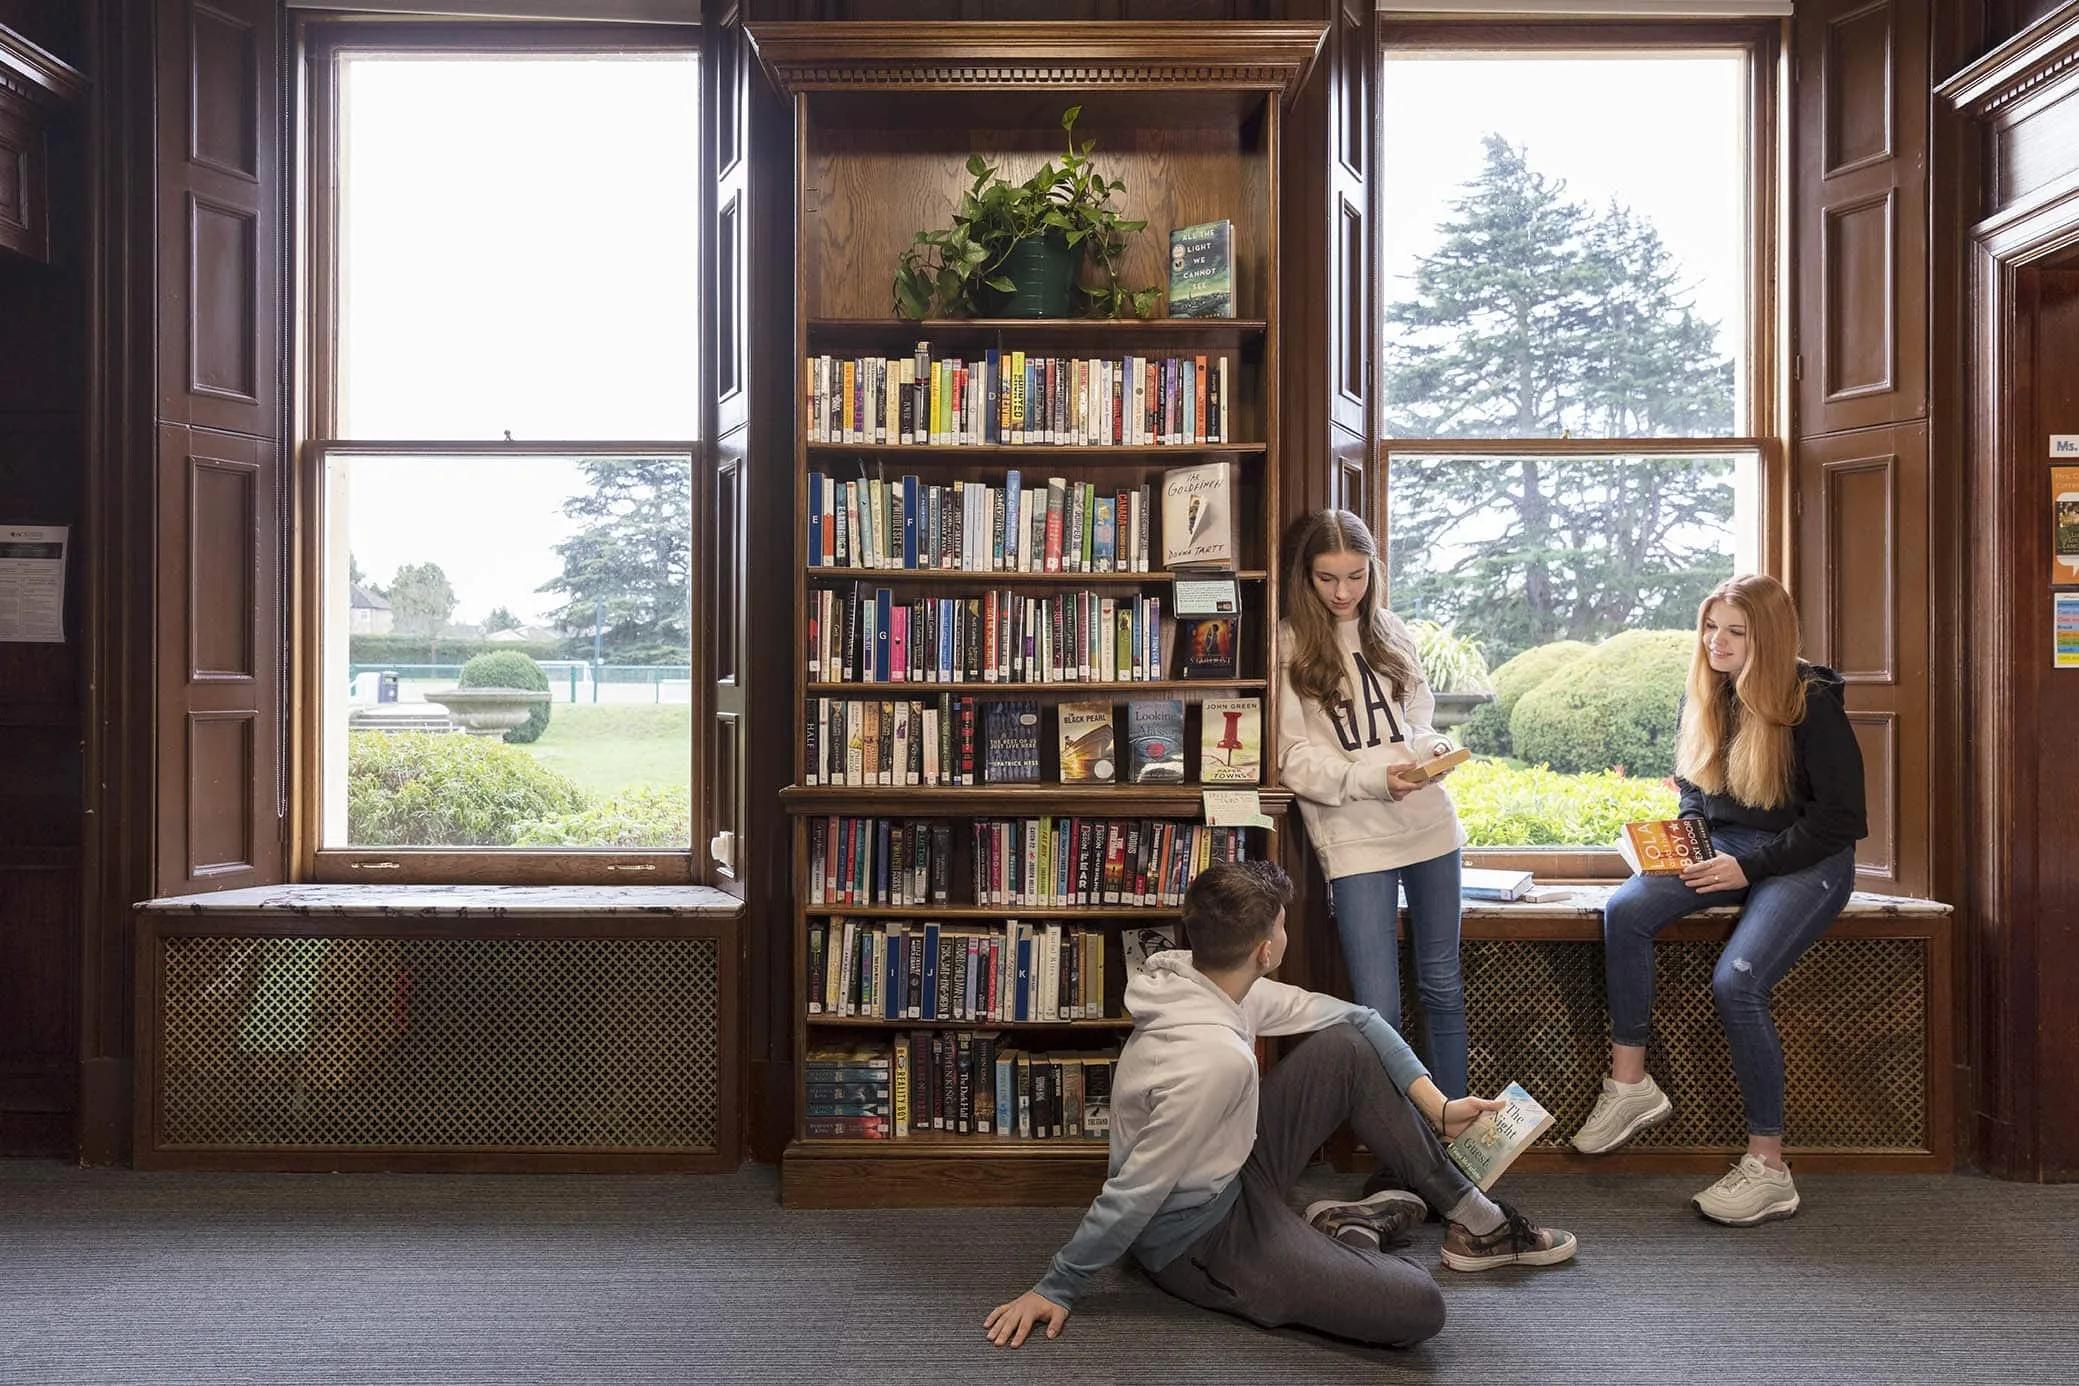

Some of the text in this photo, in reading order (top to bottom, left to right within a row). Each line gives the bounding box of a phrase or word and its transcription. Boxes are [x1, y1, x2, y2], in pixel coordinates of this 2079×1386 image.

[1187, 242, 1212, 253] LIGHT
[1193, 256, 1206, 264] WE
[1183, 267, 1217, 279] CANNOT
[988, 392, 997, 400] D
[2057, 440, 2079, 451] Ms.
[1167, 478, 1224, 497] GOLDFINCH
[1118, 493, 1128, 525] CANADA
[812, 515, 819, 524] E
[907, 518, 913, 527] F
[1194, 543, 1224, 556] TARTT
[879, 631, 887, 640] G
[1063, 713, 1106, 723] BLACK PEARL
[807, 723, 815, 749] HALF
[1683, 820, 1699, 845] DOOR
[1127, 831, 1139, 855] HORNS
[1638, 823, 1665, 869] LOLA
[1671, 834, 1694, 867] BOY
[1050, 930, 1058, 977] Burial Rites
[927, 968, 934, 977] J
[1018, 969, 1027, 979] K
[943, 1032, 954, 1105] STEPHEN KING
[896, 1071, 906, 1122] REALITY BOY
[960, 1072, 969, 1118] The Dark Half
[1506, 1102, 1524, 1124] The
[1463, 1138, 1489, 1167] Guest
